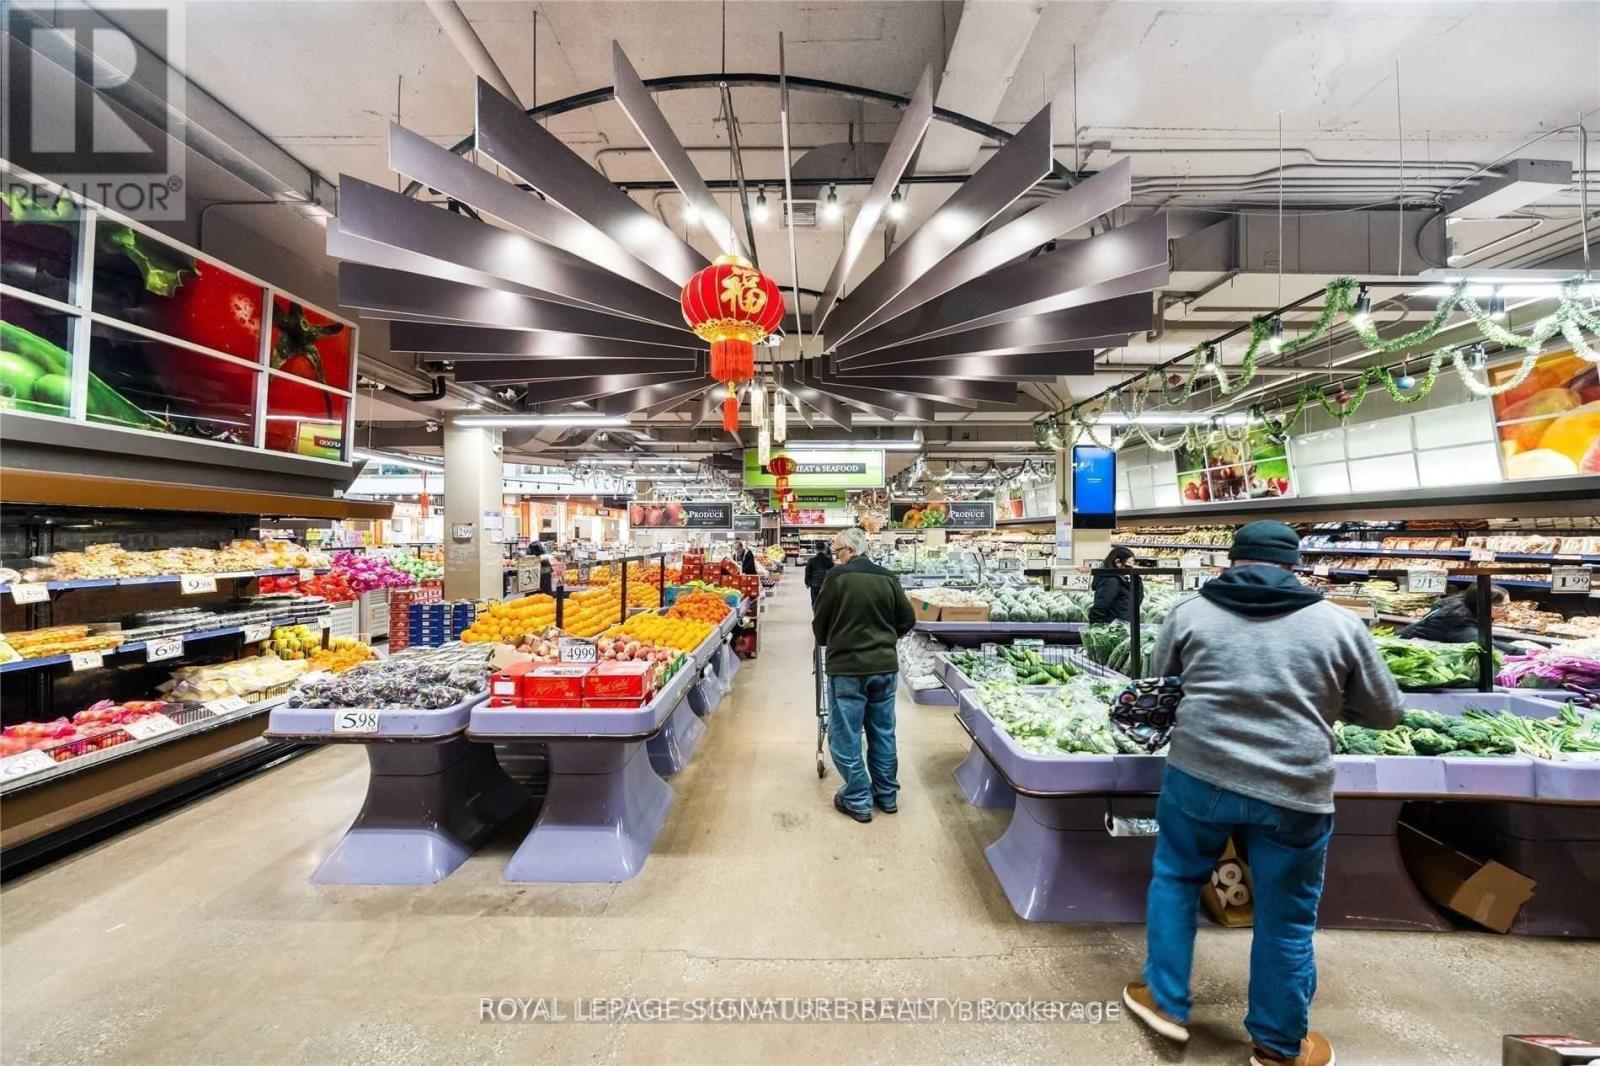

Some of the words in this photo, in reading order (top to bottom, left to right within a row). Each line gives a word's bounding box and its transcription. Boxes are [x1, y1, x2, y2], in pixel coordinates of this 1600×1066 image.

[721, 266, 767, 314] 福
[815, 465, 821, 473] &
[822, 464, 859, 473] SEAFOOD
[689, 510, 724, 518] PRODUCE
[950, 510, 985, 518] PRODUCE
[342, 712, 376, 729] 5.98
